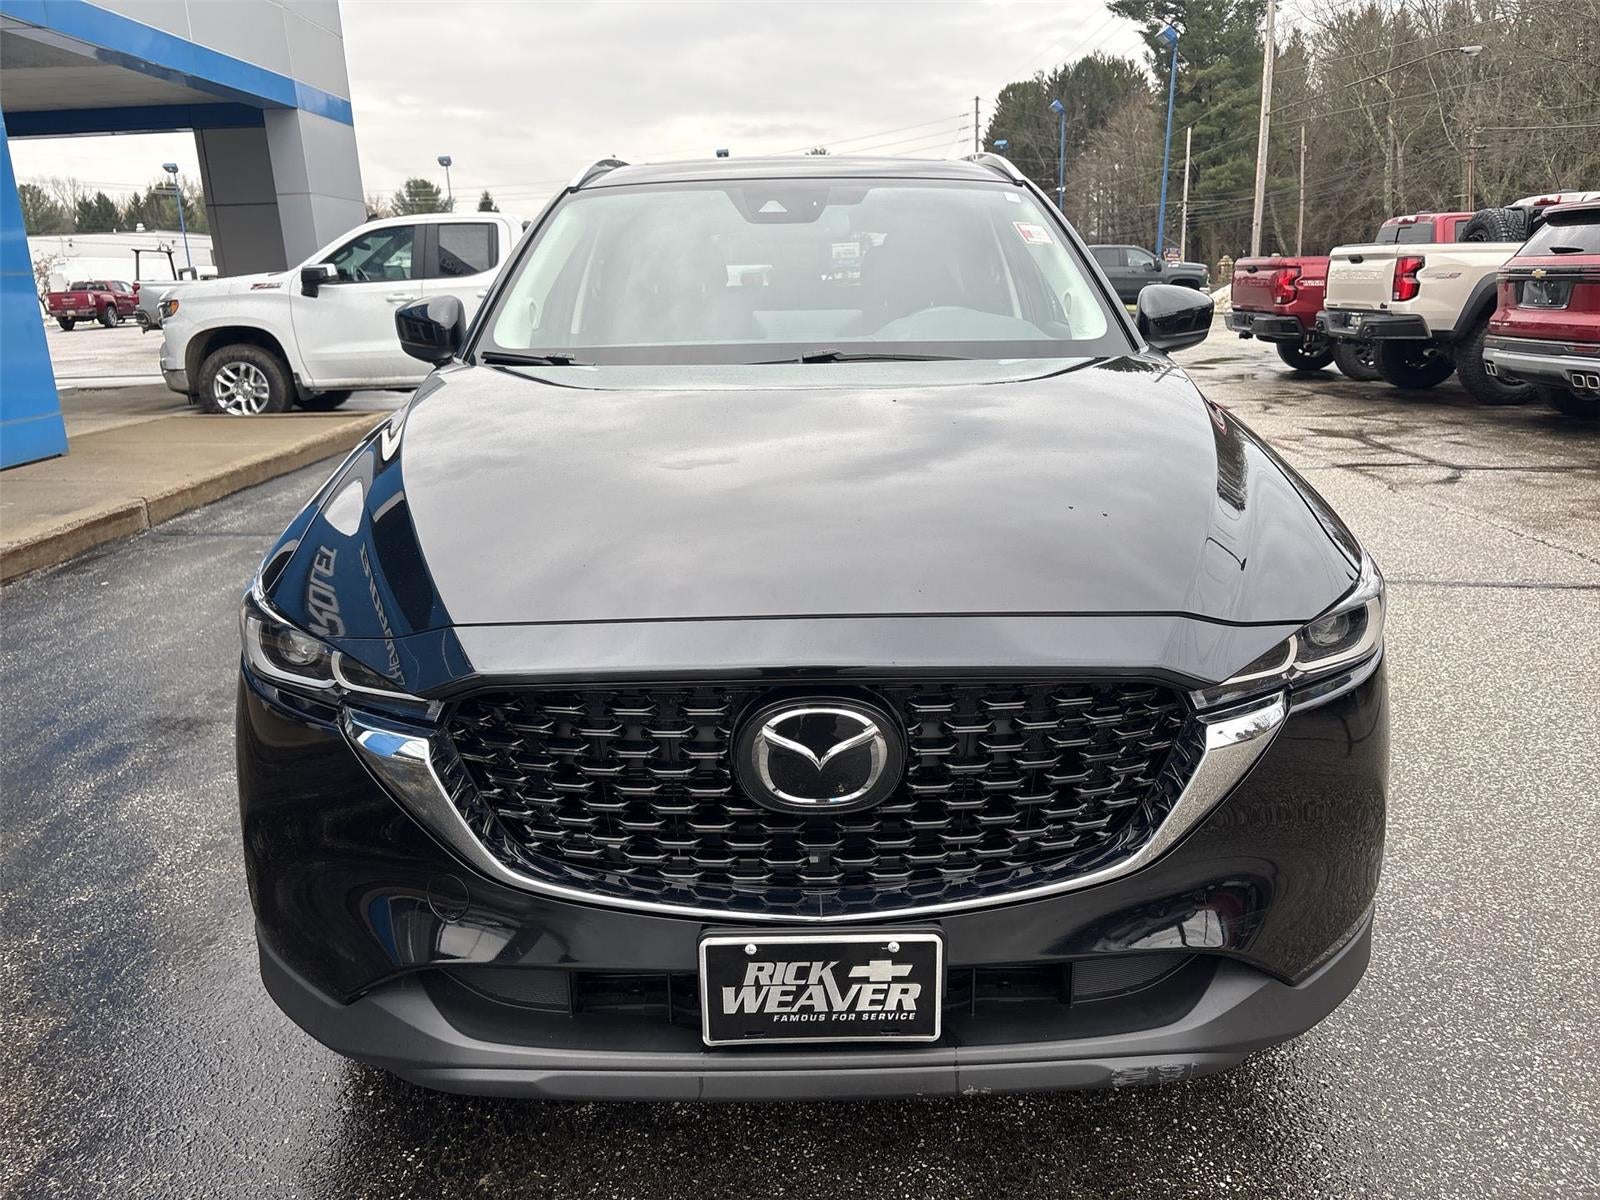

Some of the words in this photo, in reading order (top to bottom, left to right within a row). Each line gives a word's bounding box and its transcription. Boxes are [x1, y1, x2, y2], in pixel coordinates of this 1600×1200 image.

[743, 960, 839, 986] RICK
[722, 983, 922, 1014] WEAVER
[773, 1014, 826, 1022] FAMOUS
[832, 1013, 856, 1021] FOR
[862, 1012, 916, 1021] SERVICE
